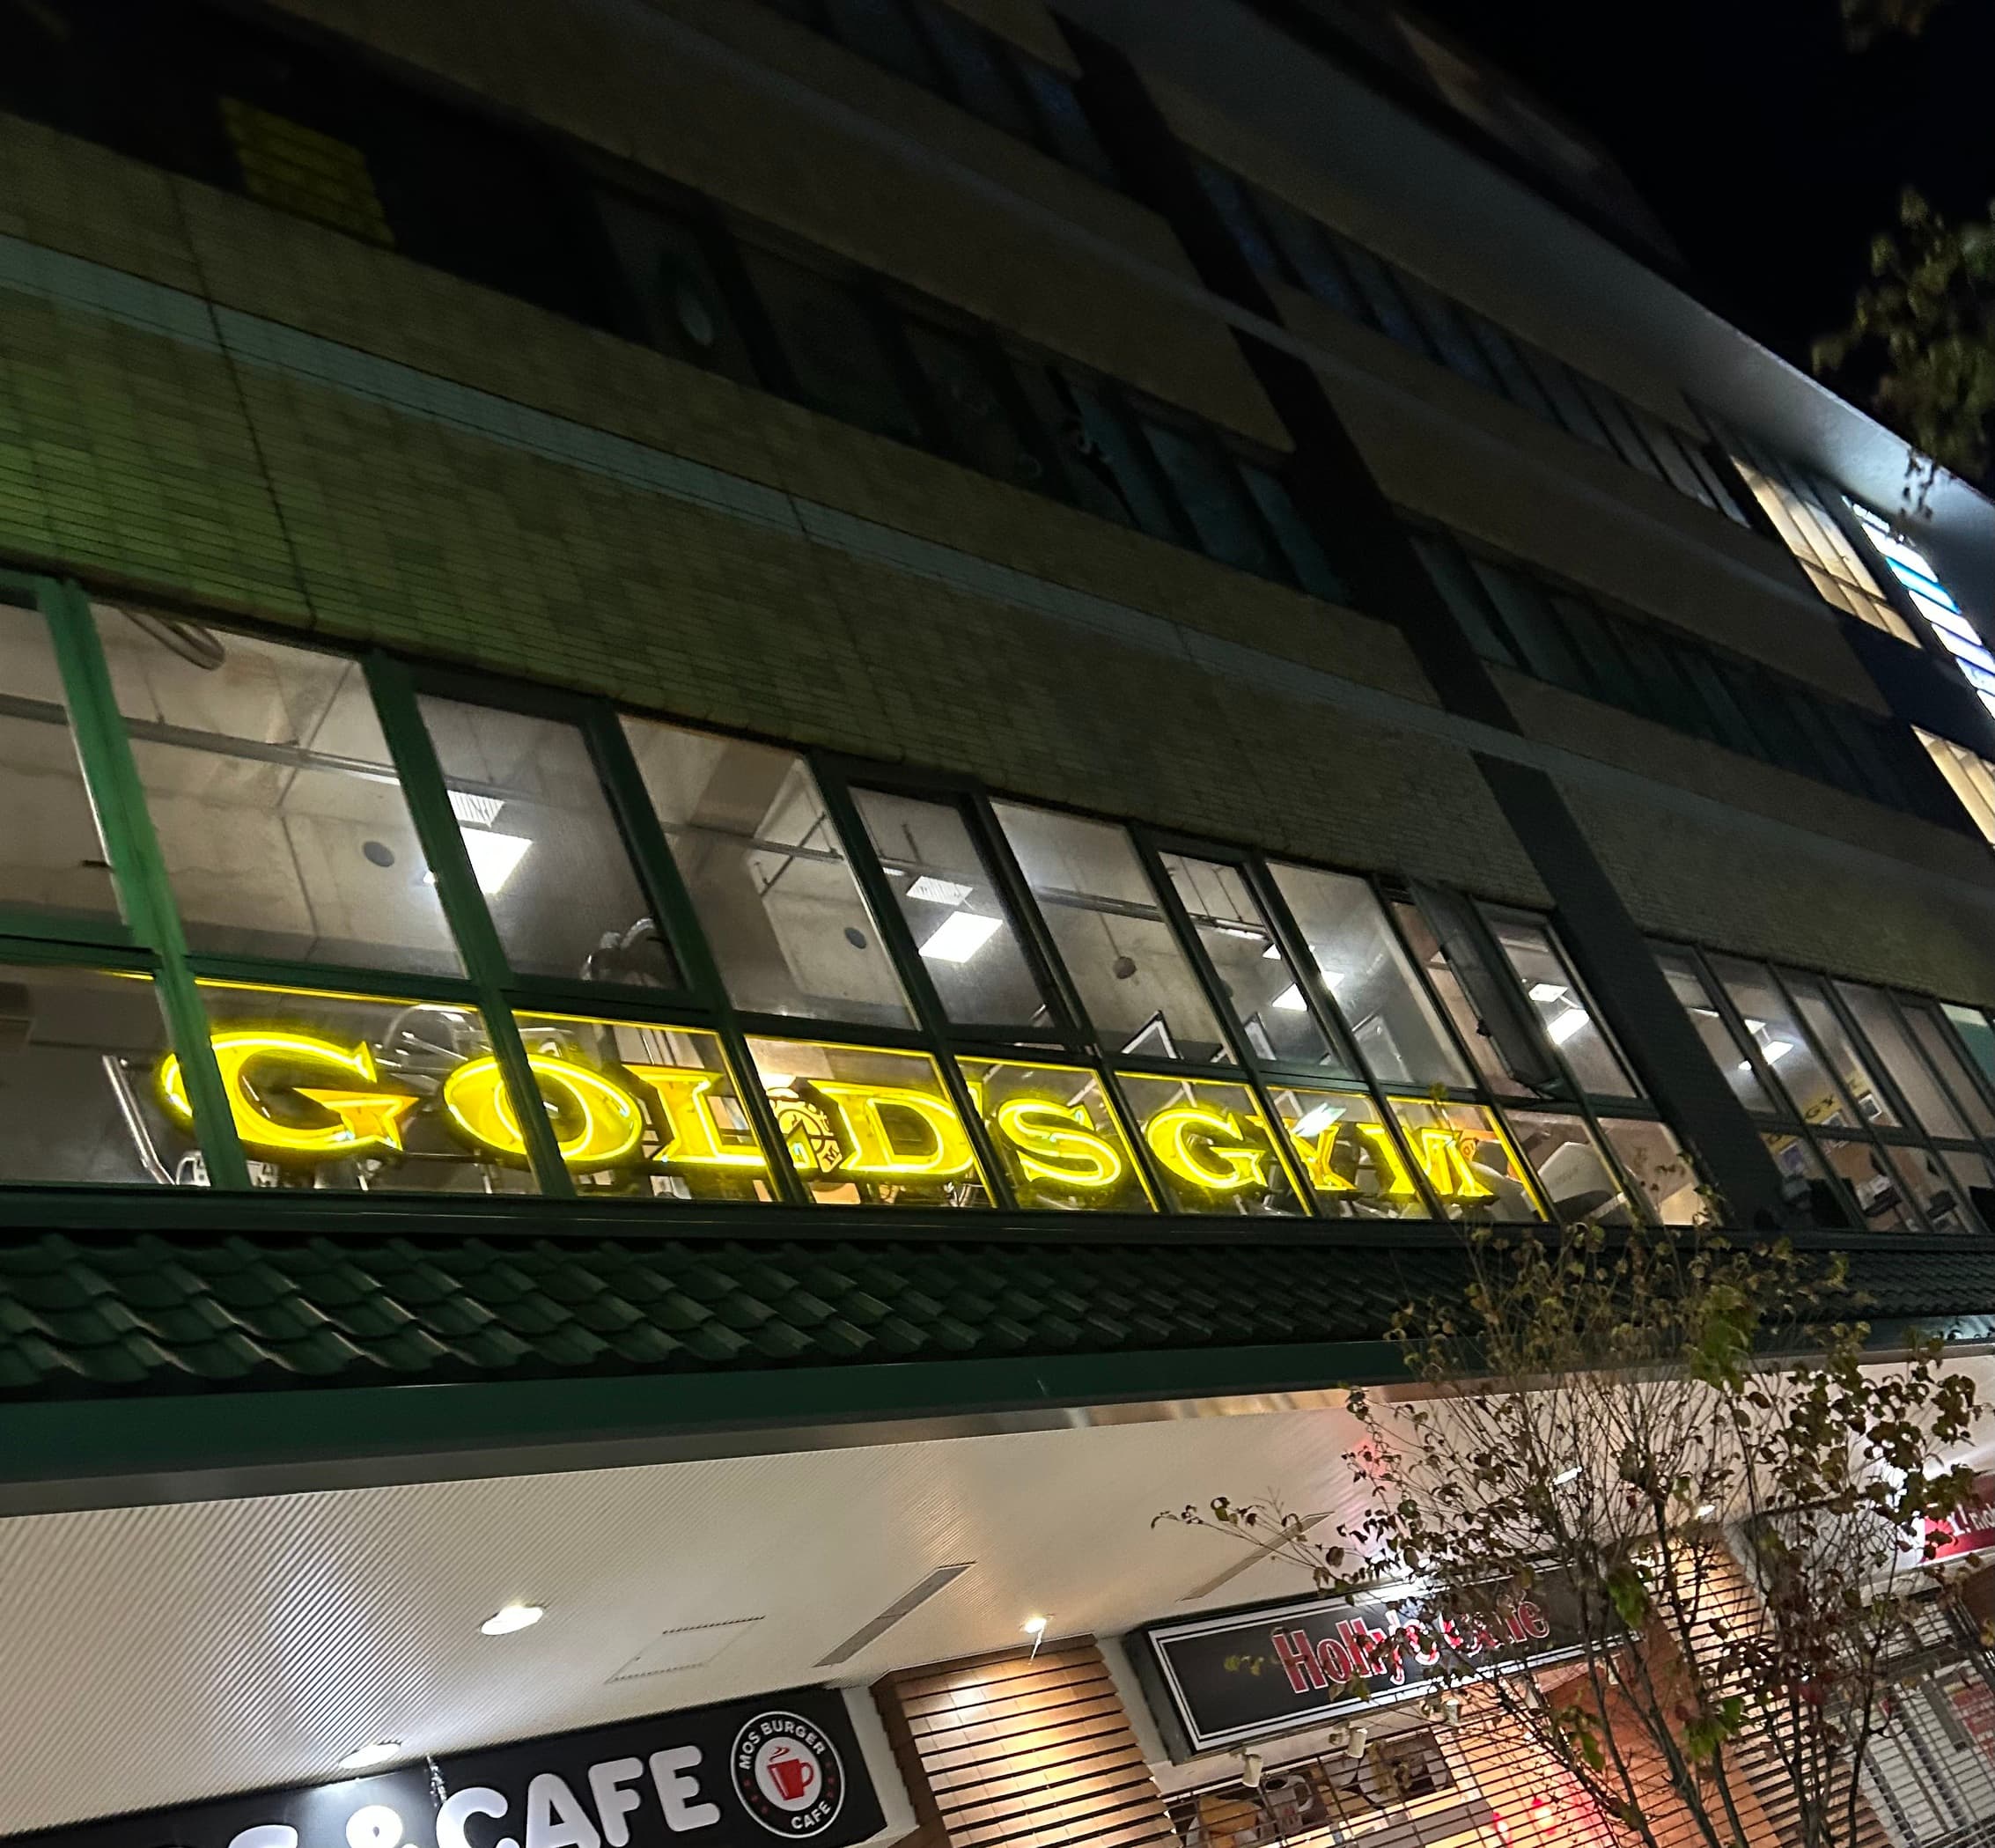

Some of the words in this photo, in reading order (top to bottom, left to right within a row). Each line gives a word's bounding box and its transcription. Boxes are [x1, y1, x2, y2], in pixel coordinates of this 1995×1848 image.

[1146, 1107, 1495, 1196] GYM
[739, 1731, 762, 1771] MOS
[760, 1719, 826, 1755] BURGER
[436, 1745, 721, 1848] CAFE
[791, 1800, 832, 1830] CAFE
